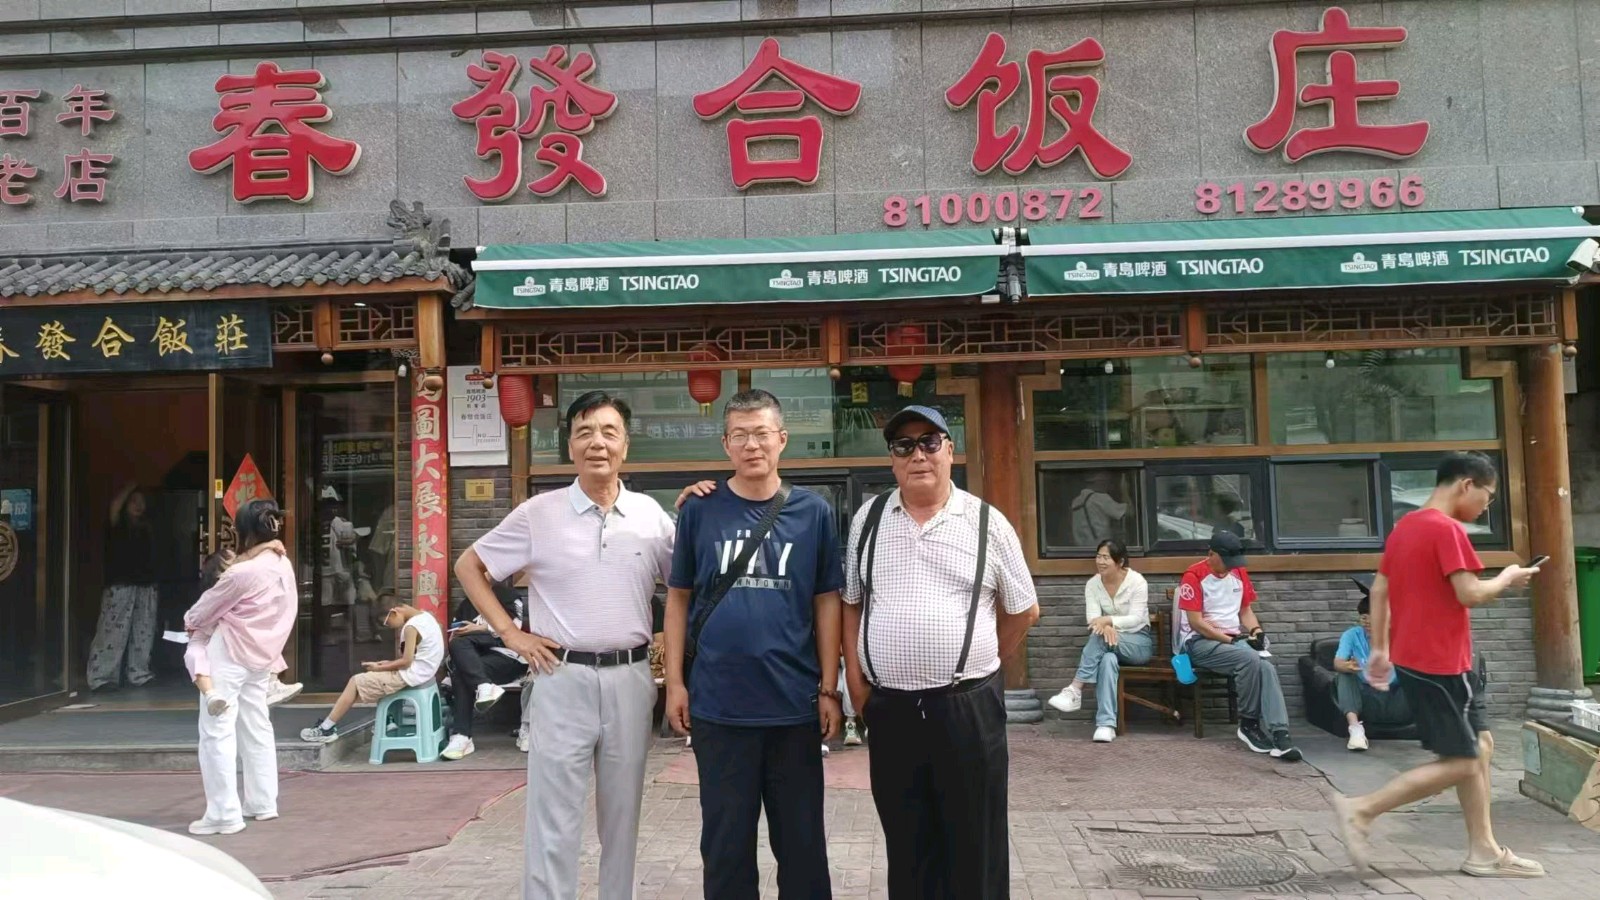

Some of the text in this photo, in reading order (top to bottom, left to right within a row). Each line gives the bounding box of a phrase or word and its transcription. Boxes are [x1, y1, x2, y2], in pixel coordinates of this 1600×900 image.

[0, 83, 116, 137] 百年
[188, 6, 1431, 204] 春發合饭庄
[0, 148, 114, 205] 老店
[1195, 175, 1426, 215] 81289966
[883, 188, 1103, 228] 81000872
[1103, 257, 1265, 278] 青島啤酒 TSINGTAO
[1381, 247, 1551, 270] 青島啤酒 TSINGTAO
[549, 274, 700, 293] 青島啤酒 TSINGTAO
[807, 266, 962, 286] 青島啤酒 TSINGTAO
[466, 394, 486, 403] 1903
[736, 578, 790, 588] WNTOWN
